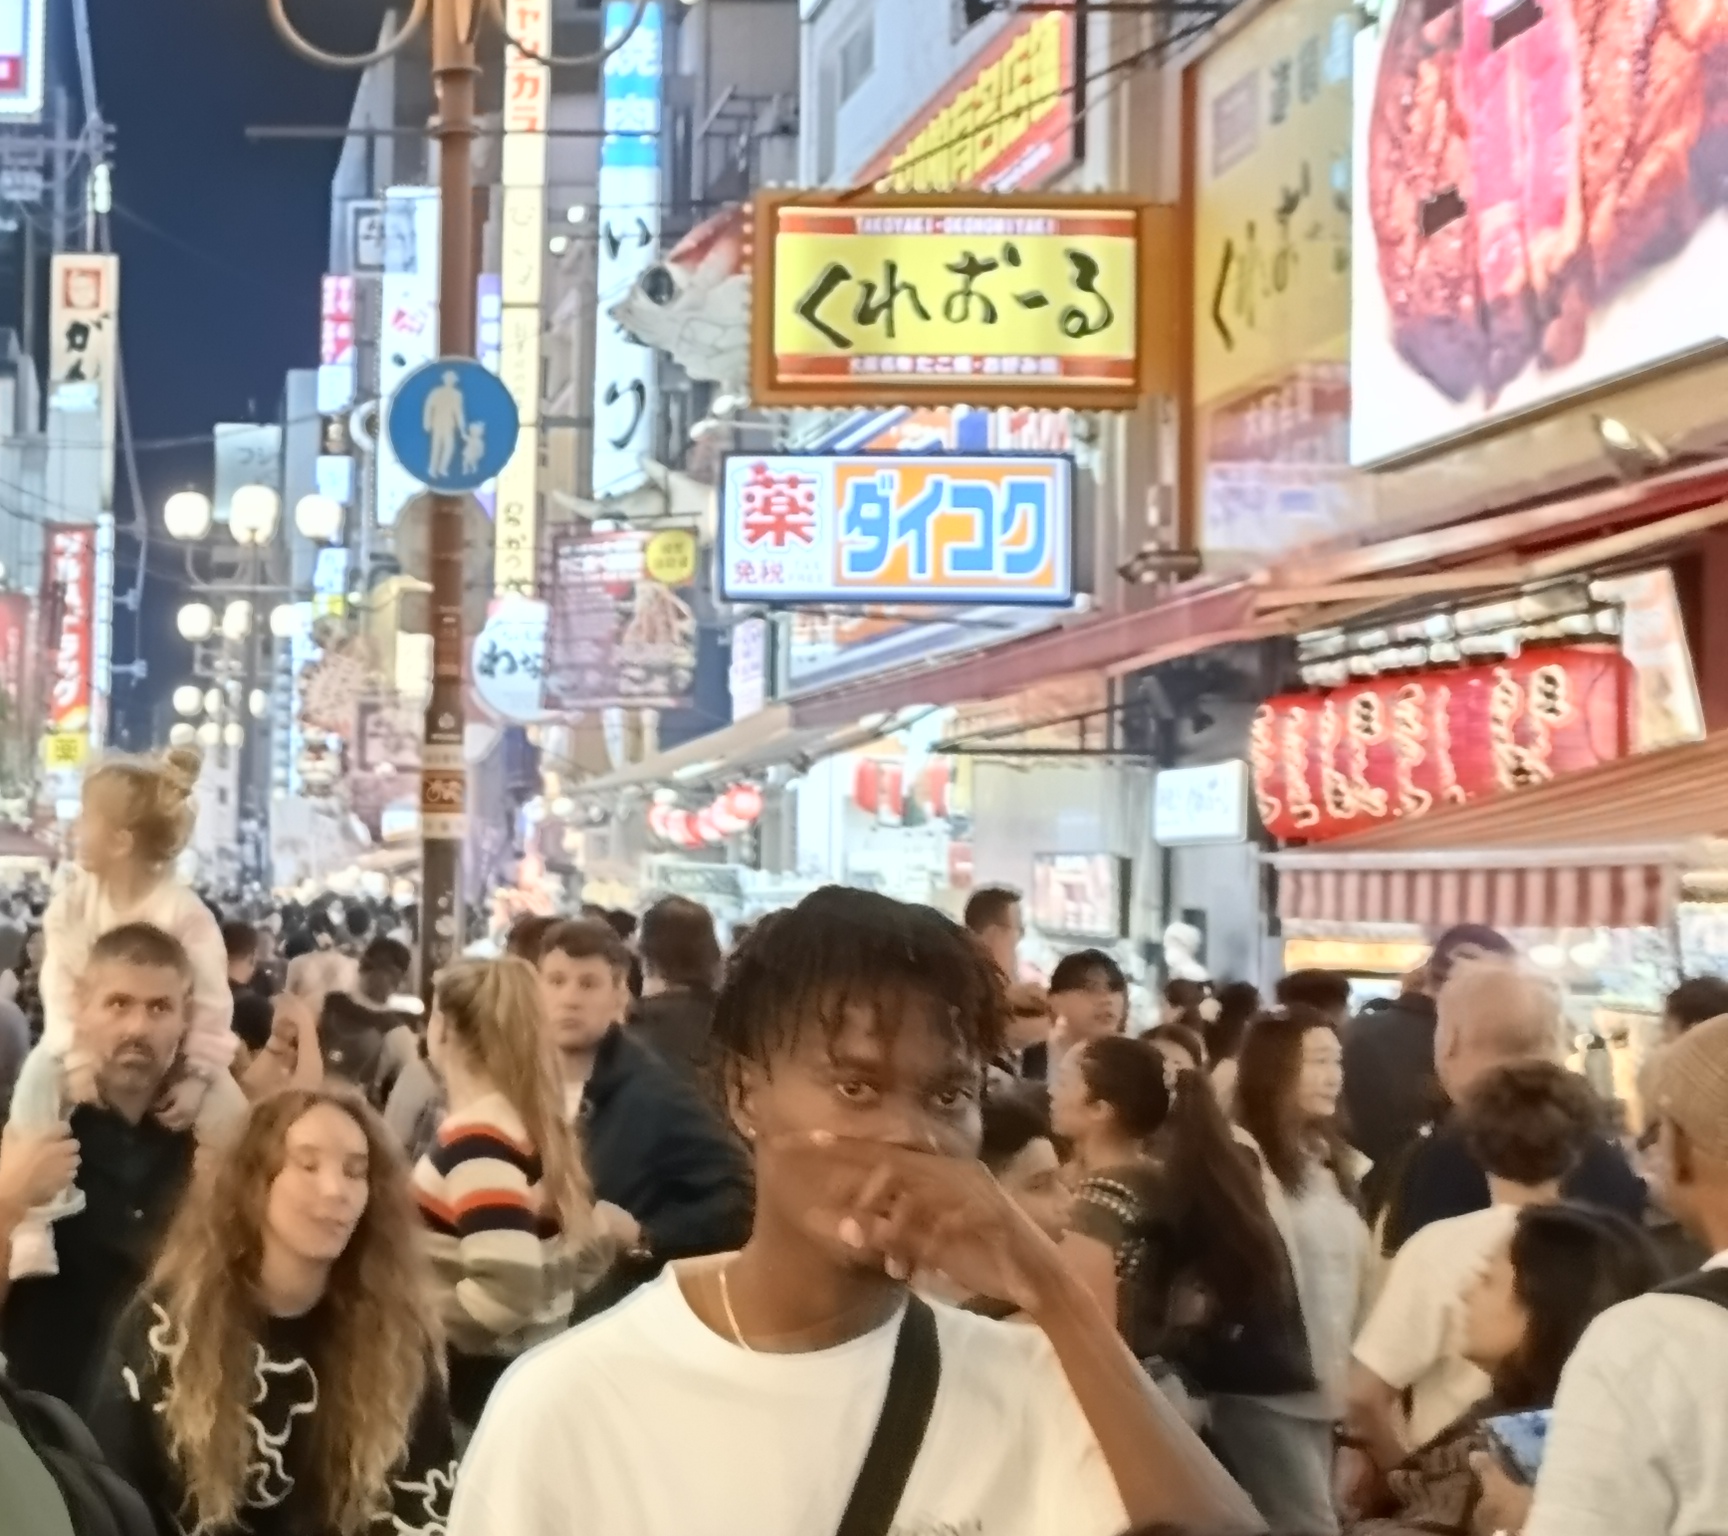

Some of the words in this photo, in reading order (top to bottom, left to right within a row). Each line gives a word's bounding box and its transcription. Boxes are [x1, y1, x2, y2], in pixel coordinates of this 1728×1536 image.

[796, 241, 1114, 350] くれおーる
[743, 461, 819, 548] 薬
[841, 472, 1049, 577] ダイコク
[733, 559, 785, 584] 免税
